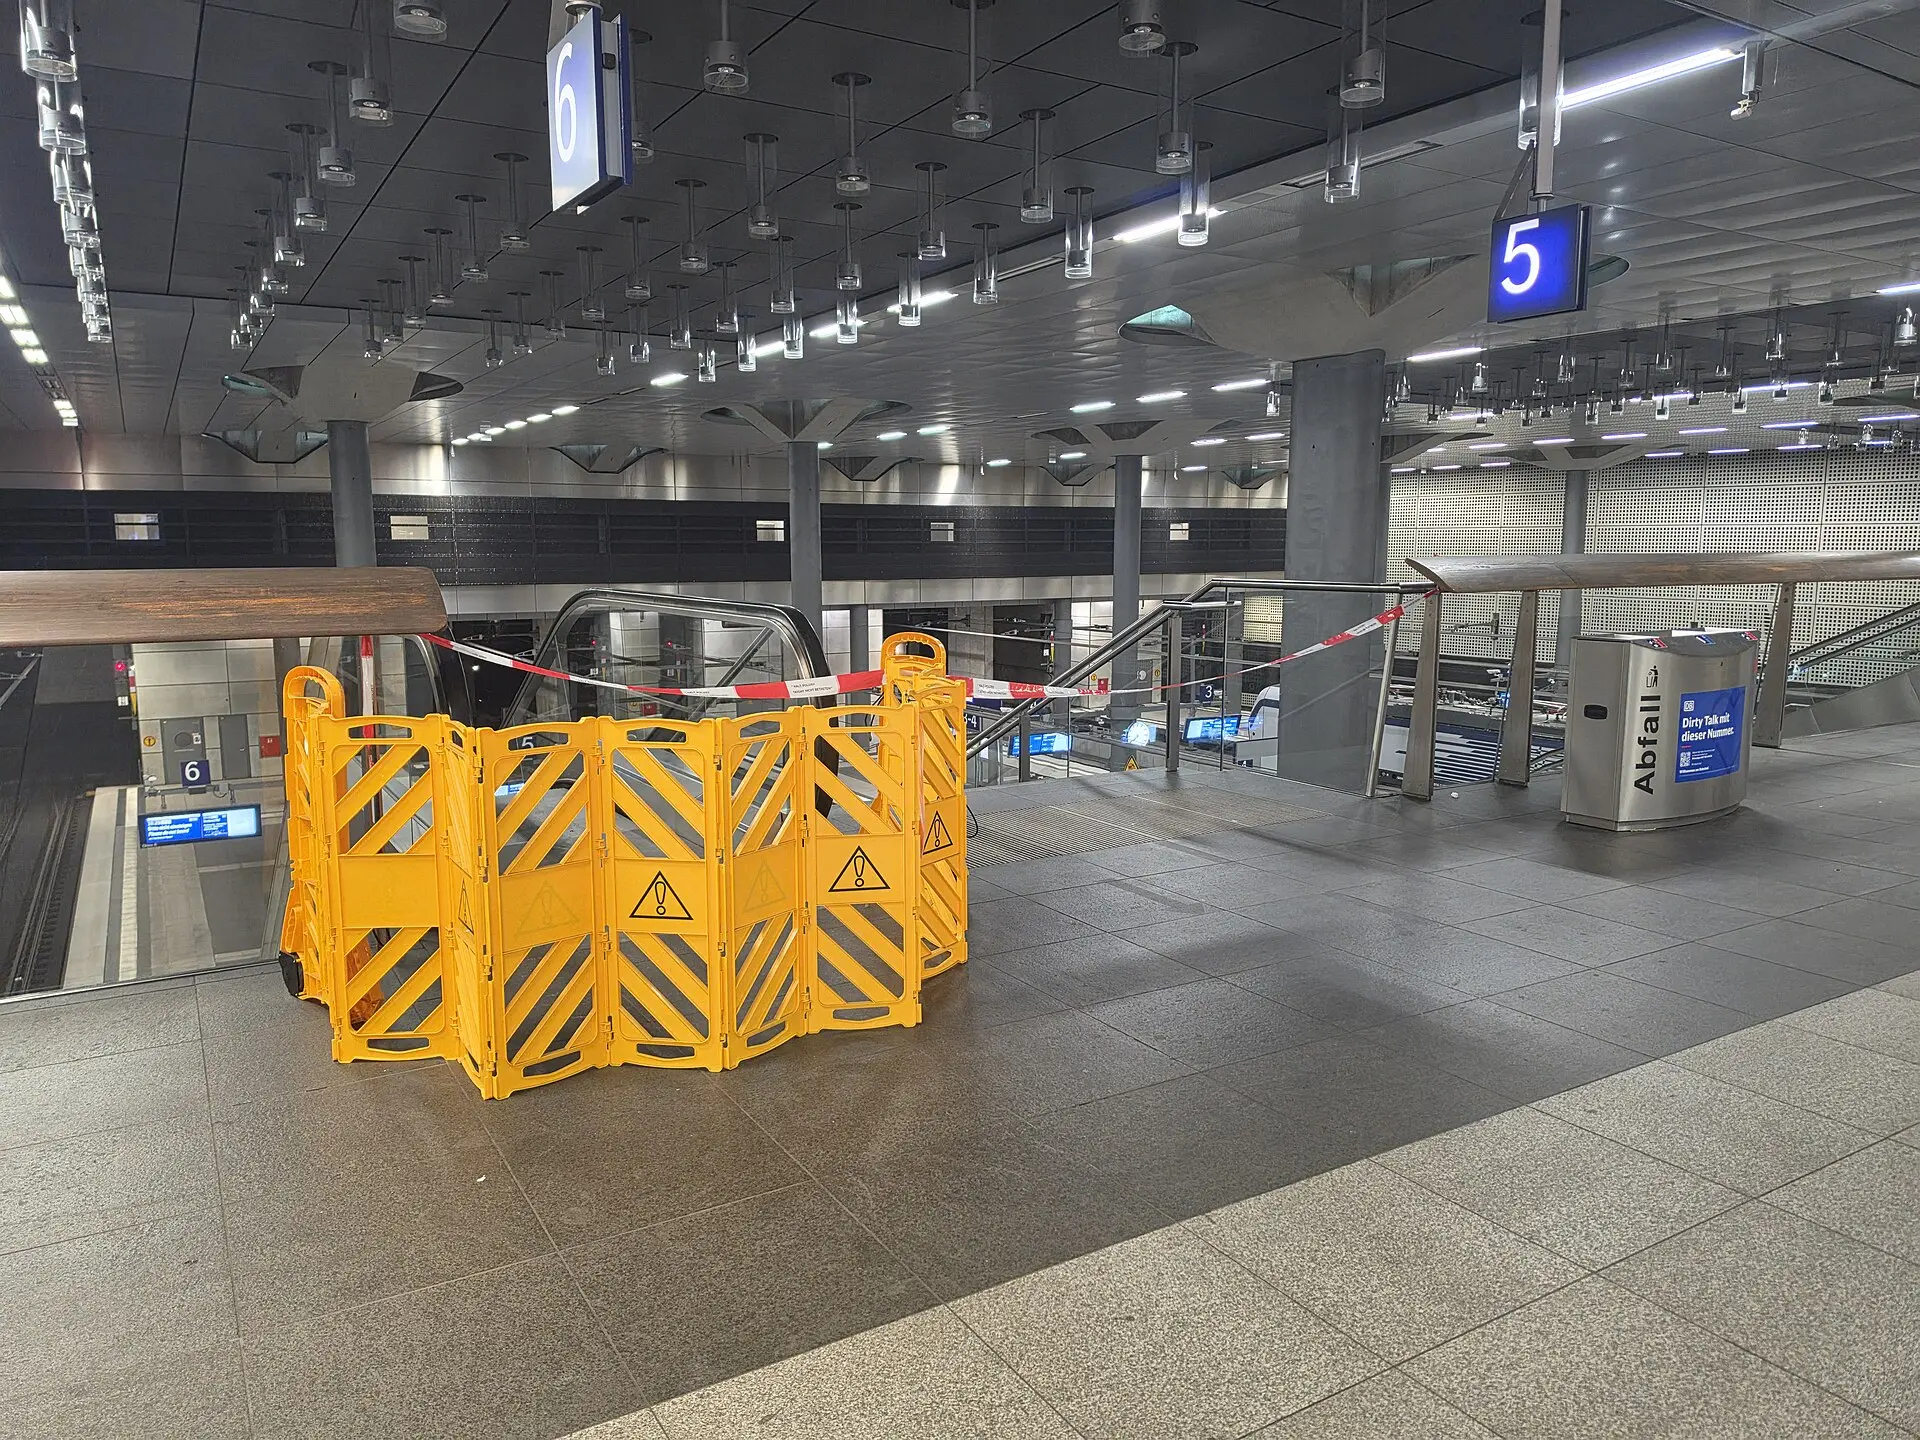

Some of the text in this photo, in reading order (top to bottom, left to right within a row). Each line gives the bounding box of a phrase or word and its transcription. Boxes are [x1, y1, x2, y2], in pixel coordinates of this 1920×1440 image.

[555, 42, 577, 162] 6
[1501, 218, 1540, 294] 5
[1205, 685, 1212, 698] 3
[1682, 712, 1730, 729] Dirty Talk mit
[522, 736, 534, 748] 5
[1681, 727, 1735, 742] dieser Nummer.
[1634, 695, 1661, 795] Abfall
[185, 761, 200, 781] 6
